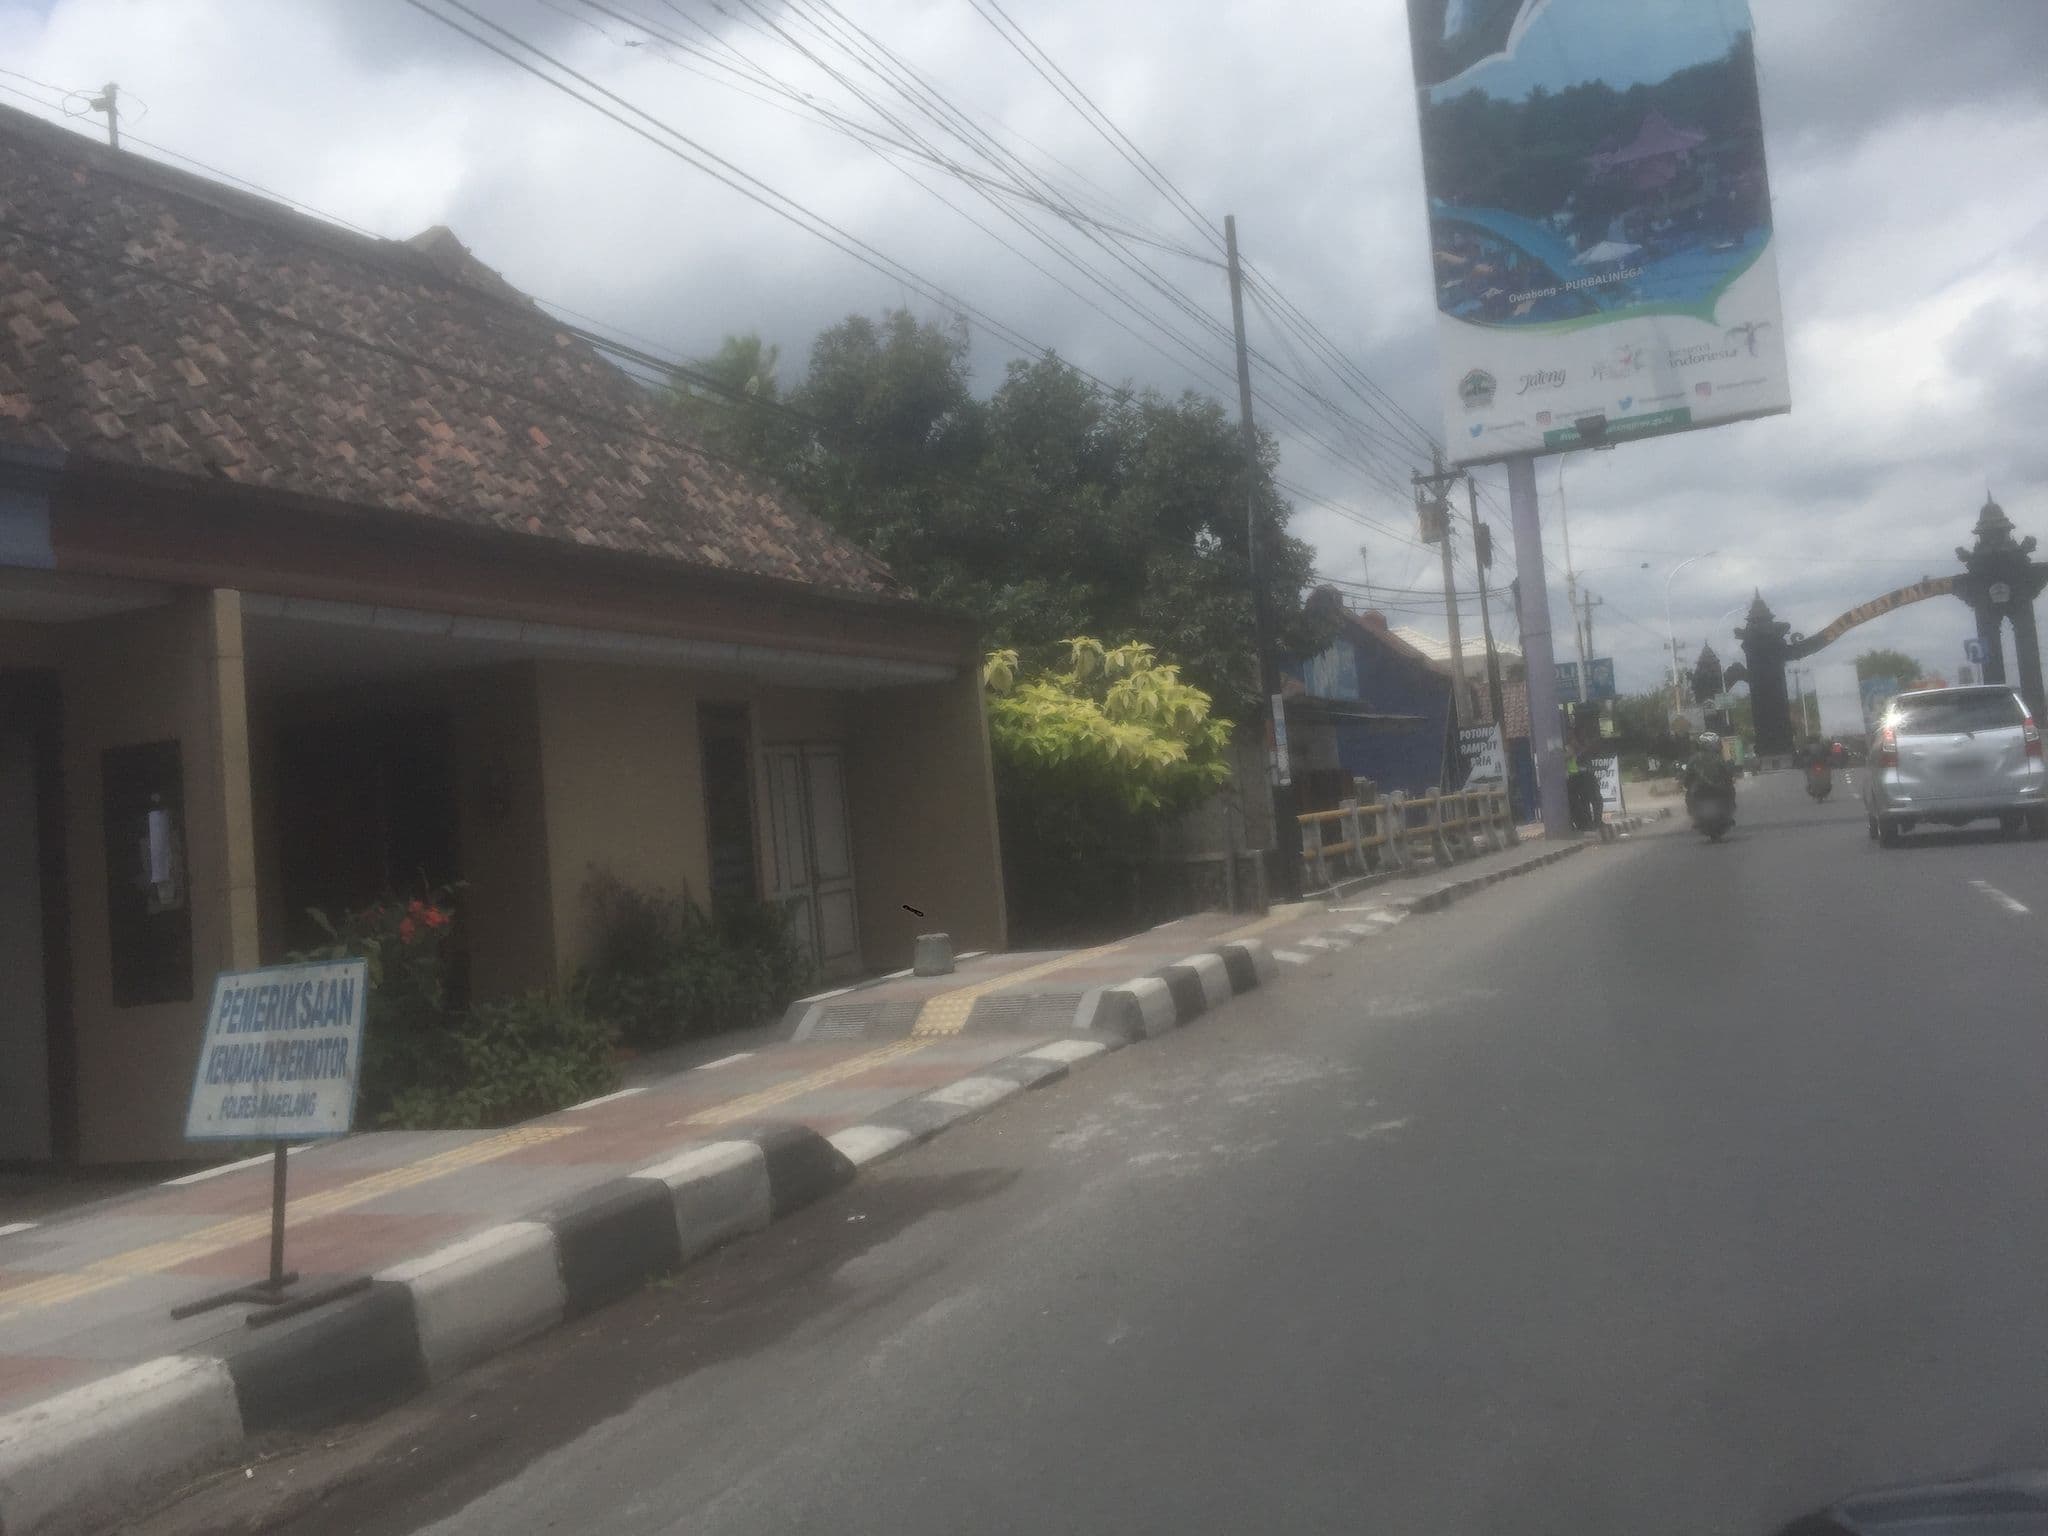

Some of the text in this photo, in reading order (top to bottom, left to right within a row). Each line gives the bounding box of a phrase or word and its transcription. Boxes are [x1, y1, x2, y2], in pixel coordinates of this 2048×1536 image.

[1508, 286, 1557, 304] Owabong
[1565, 266, 1644, 291] PURBALINGGA
[216, 978, 355, 1034] PEMERIKSAAN
[206, 1037, 348, 1085] KENDARAAN BERMOTOR
